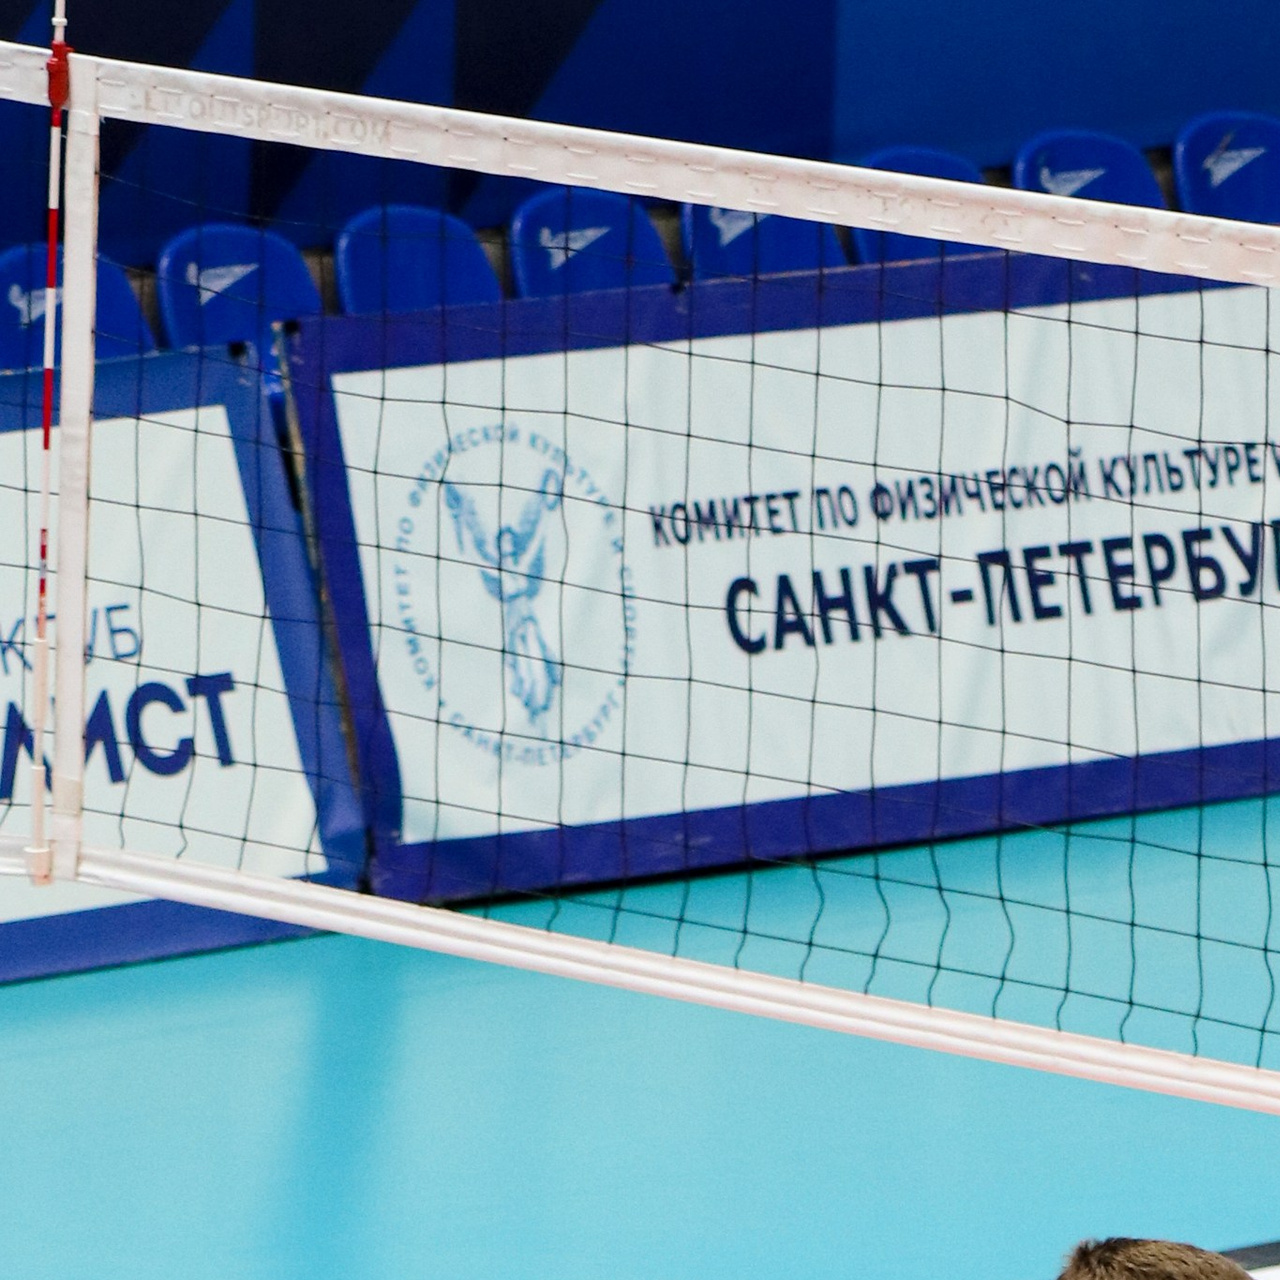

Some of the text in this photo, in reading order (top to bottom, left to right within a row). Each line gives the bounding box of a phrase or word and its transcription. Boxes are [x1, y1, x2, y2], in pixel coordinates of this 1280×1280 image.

[650, 490, 802, 548] КОМИТЕТ
[814, 485, 859, 531] ПО
[869, 446, 1091, 525] ФИЗИЧЕСКОЙ
[1101, 441, 1264, 499] КУЛЬТУРЕ
